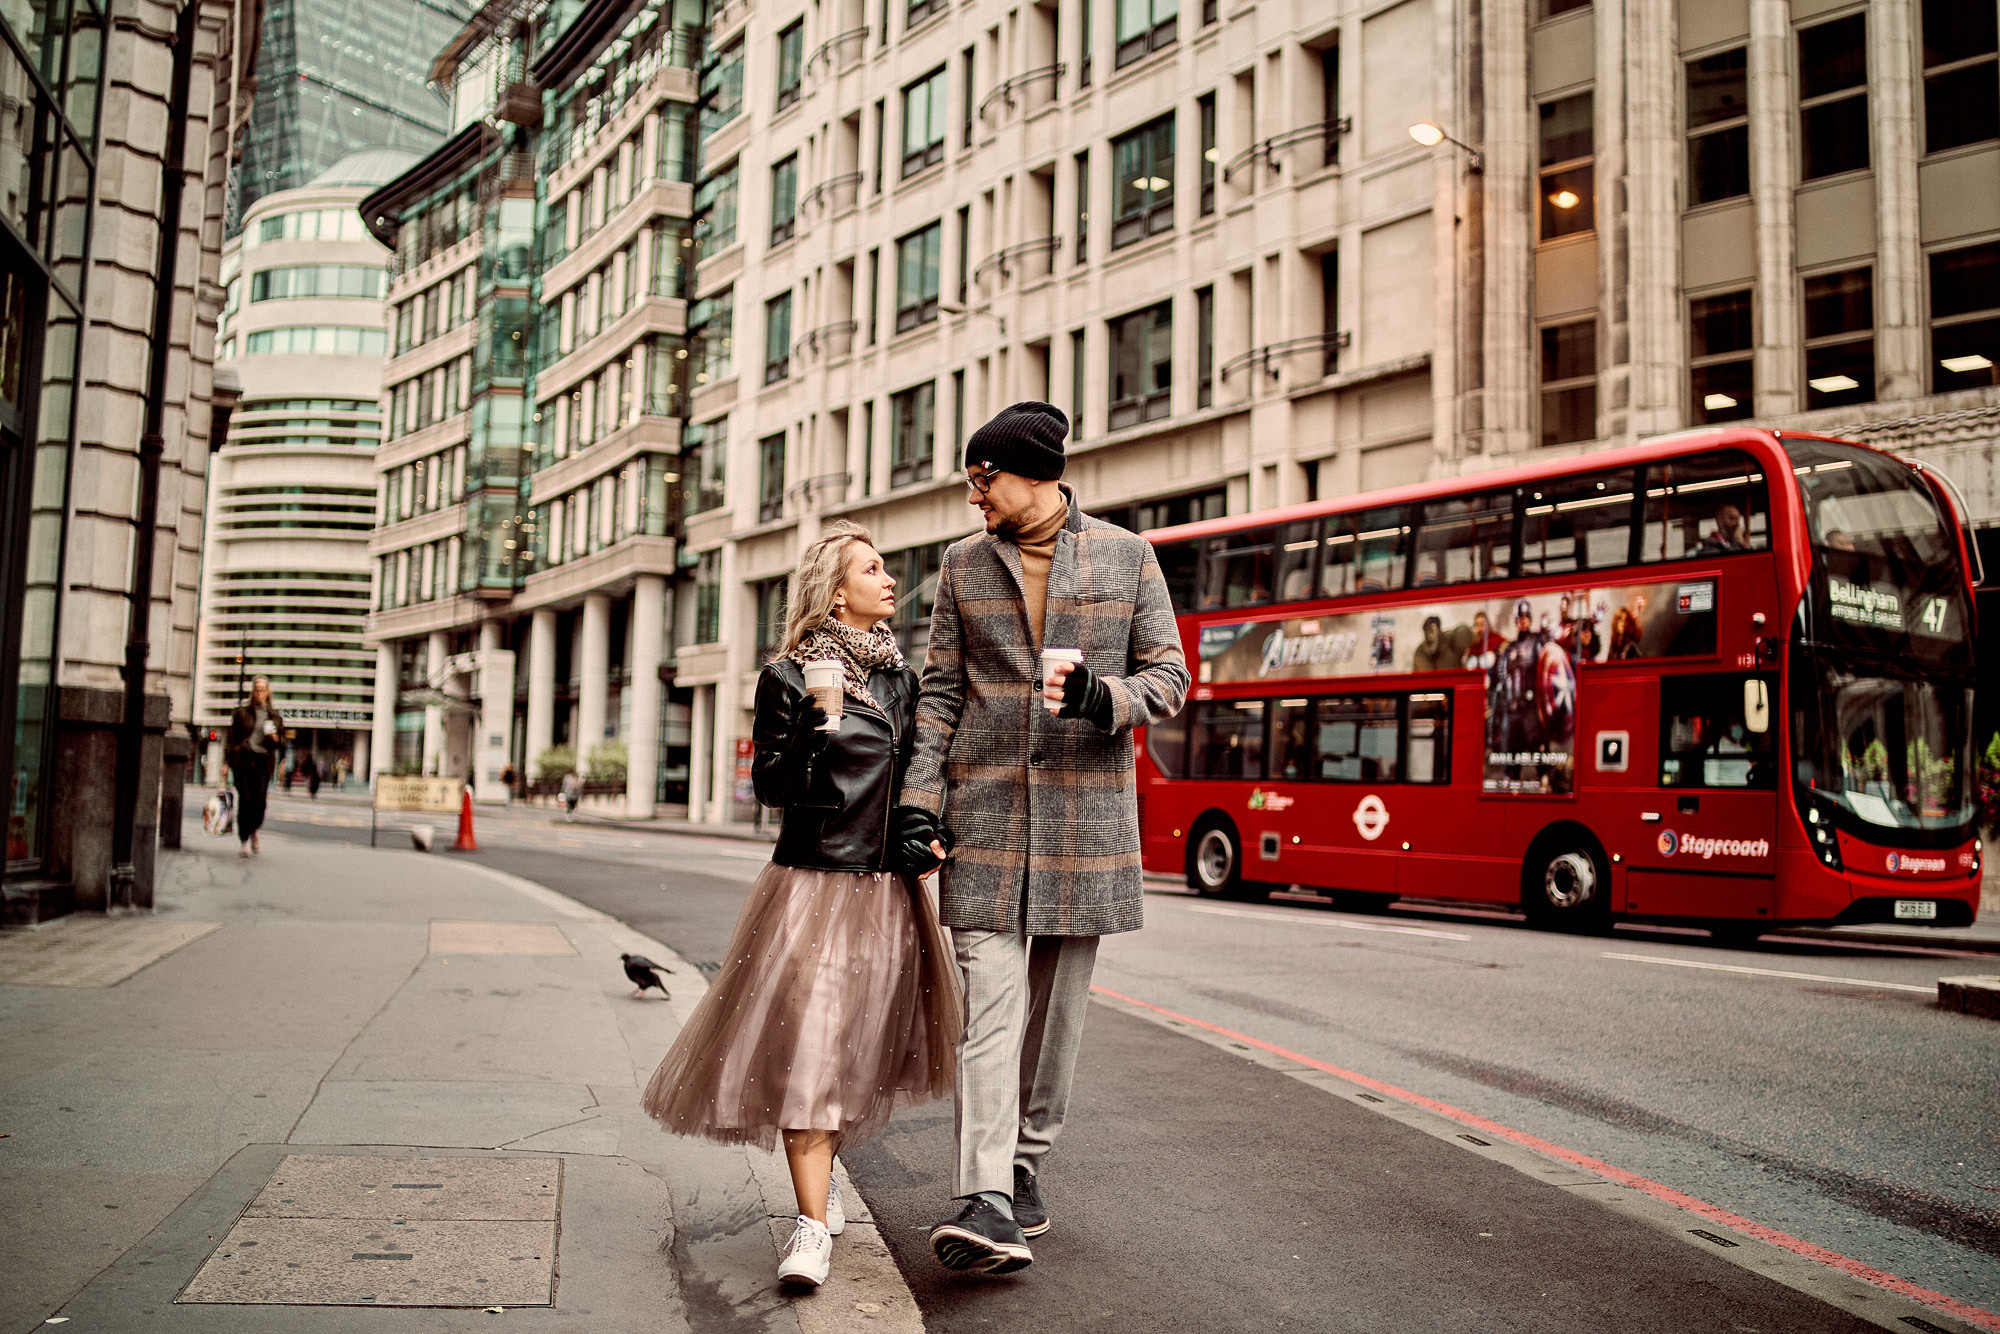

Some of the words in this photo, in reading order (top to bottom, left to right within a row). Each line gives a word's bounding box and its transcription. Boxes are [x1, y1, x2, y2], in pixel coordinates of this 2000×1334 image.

[1829, 580, 1899, 612] Bellingham
[1922, 598, 1948, 633] 47
[1258, 628, 1358, 678] AVENGERS
[1680, 833, 1769, 859] Stagecoach
